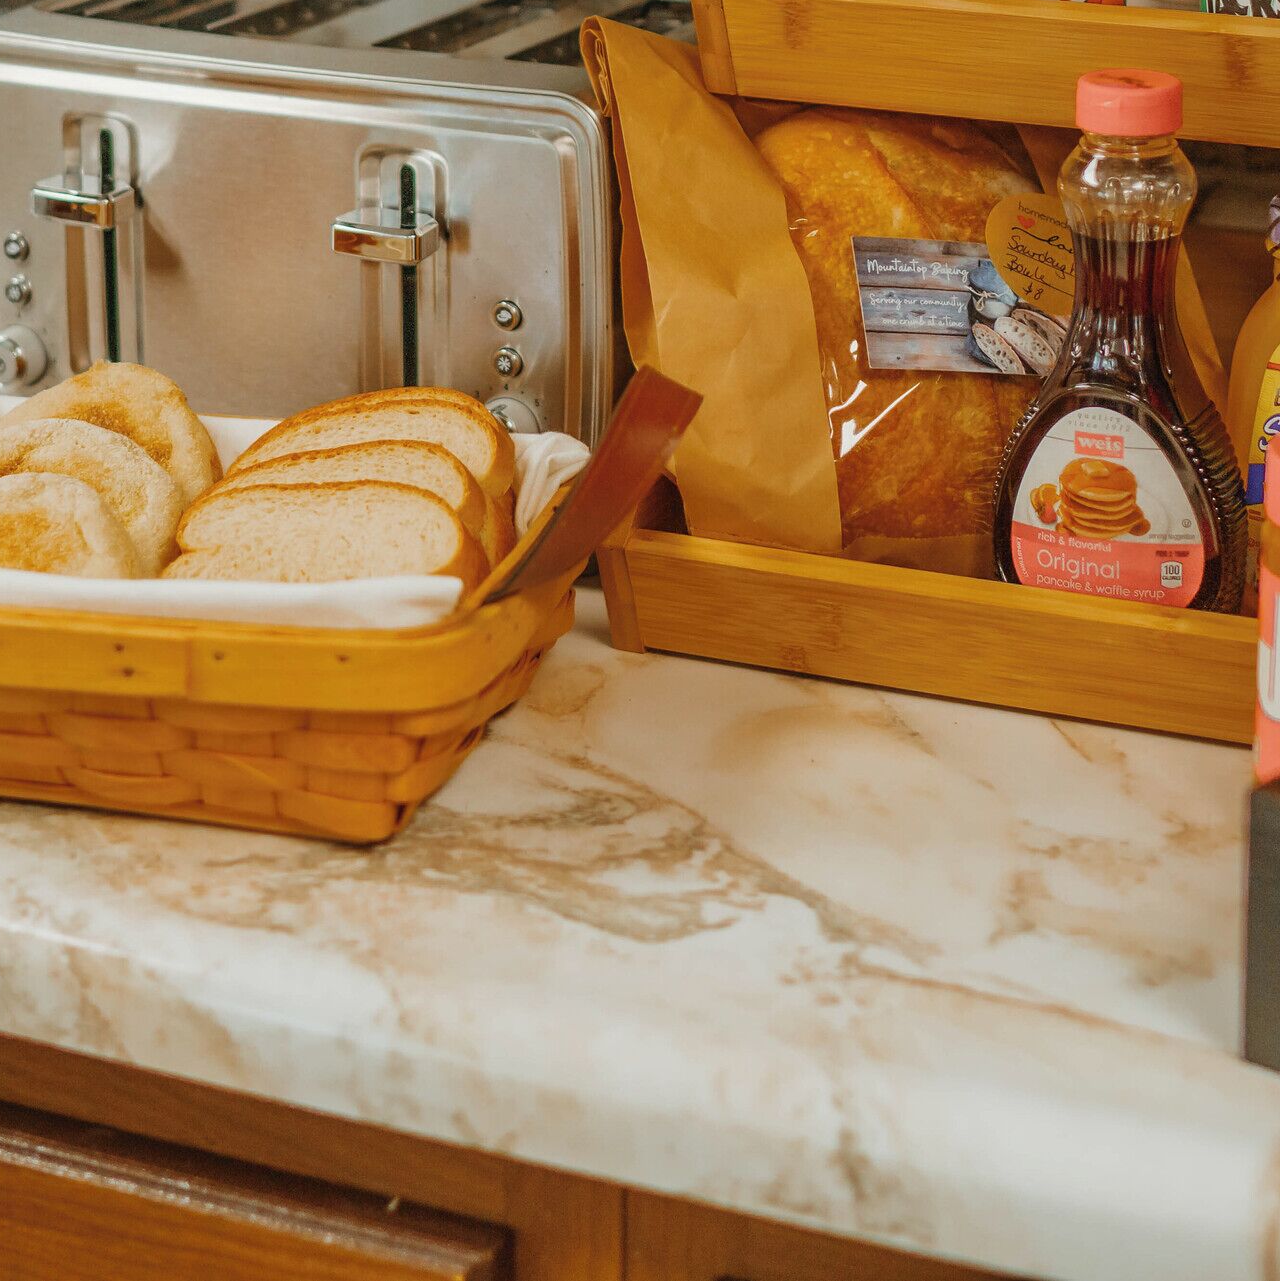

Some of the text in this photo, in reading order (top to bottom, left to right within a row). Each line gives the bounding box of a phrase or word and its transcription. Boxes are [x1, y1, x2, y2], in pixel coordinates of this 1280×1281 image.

[867, 258, 969, 283] Mountaintop Baking
[870, 293, 901, 311] Serving
[899, 316, 925, 325] crumb
[1068, 420, 1098, 429] since
[1077, 436, 1123, 451] weis
[1038, 531, 1112, 553] rich & flavorful
[1037, 549, 1120, 580] Original
[1164, 565, 1180, 575] 100
[1036, 574, 1165, 601] pancake & waffle syrup
